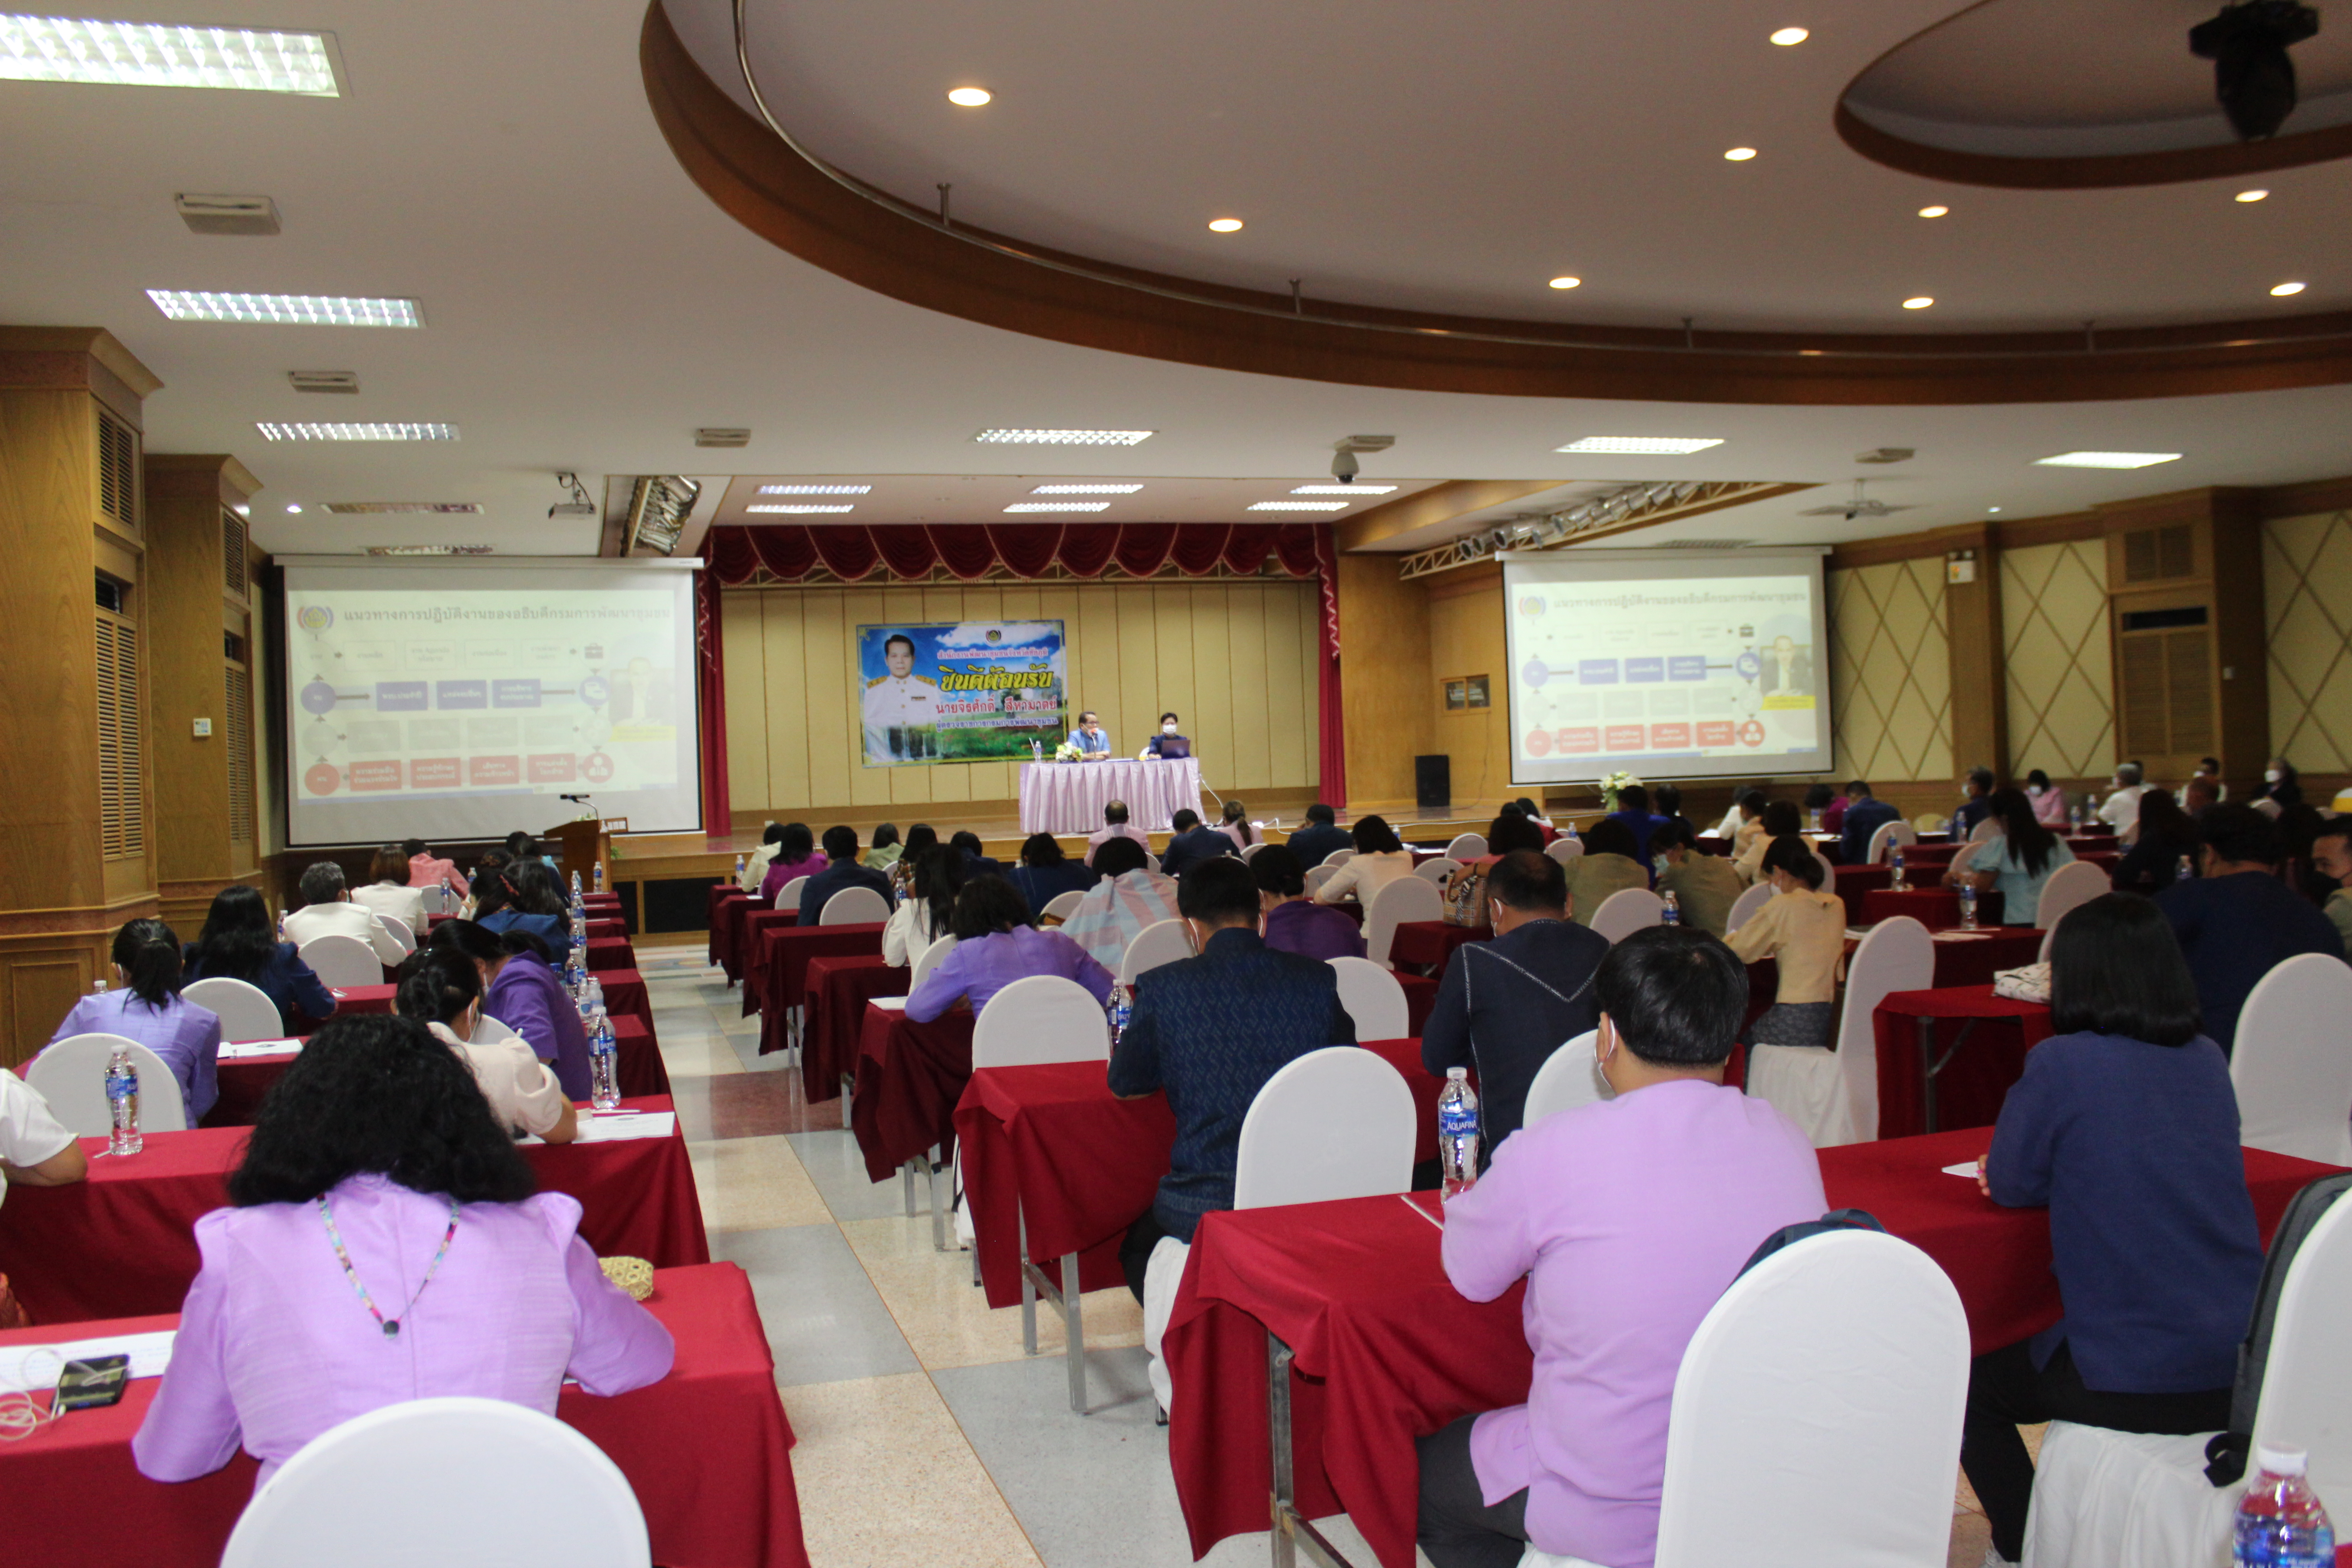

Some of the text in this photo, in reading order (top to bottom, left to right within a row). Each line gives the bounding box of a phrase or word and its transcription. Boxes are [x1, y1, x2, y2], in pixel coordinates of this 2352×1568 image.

[938, 663, 1054, 691] ยินดีต้อนรับ
[936, 694, 1057, 713] นายจิรศักดิ์ สีหามาตย์
[1447, 1120, 1477, 1131] AQUAFINA
